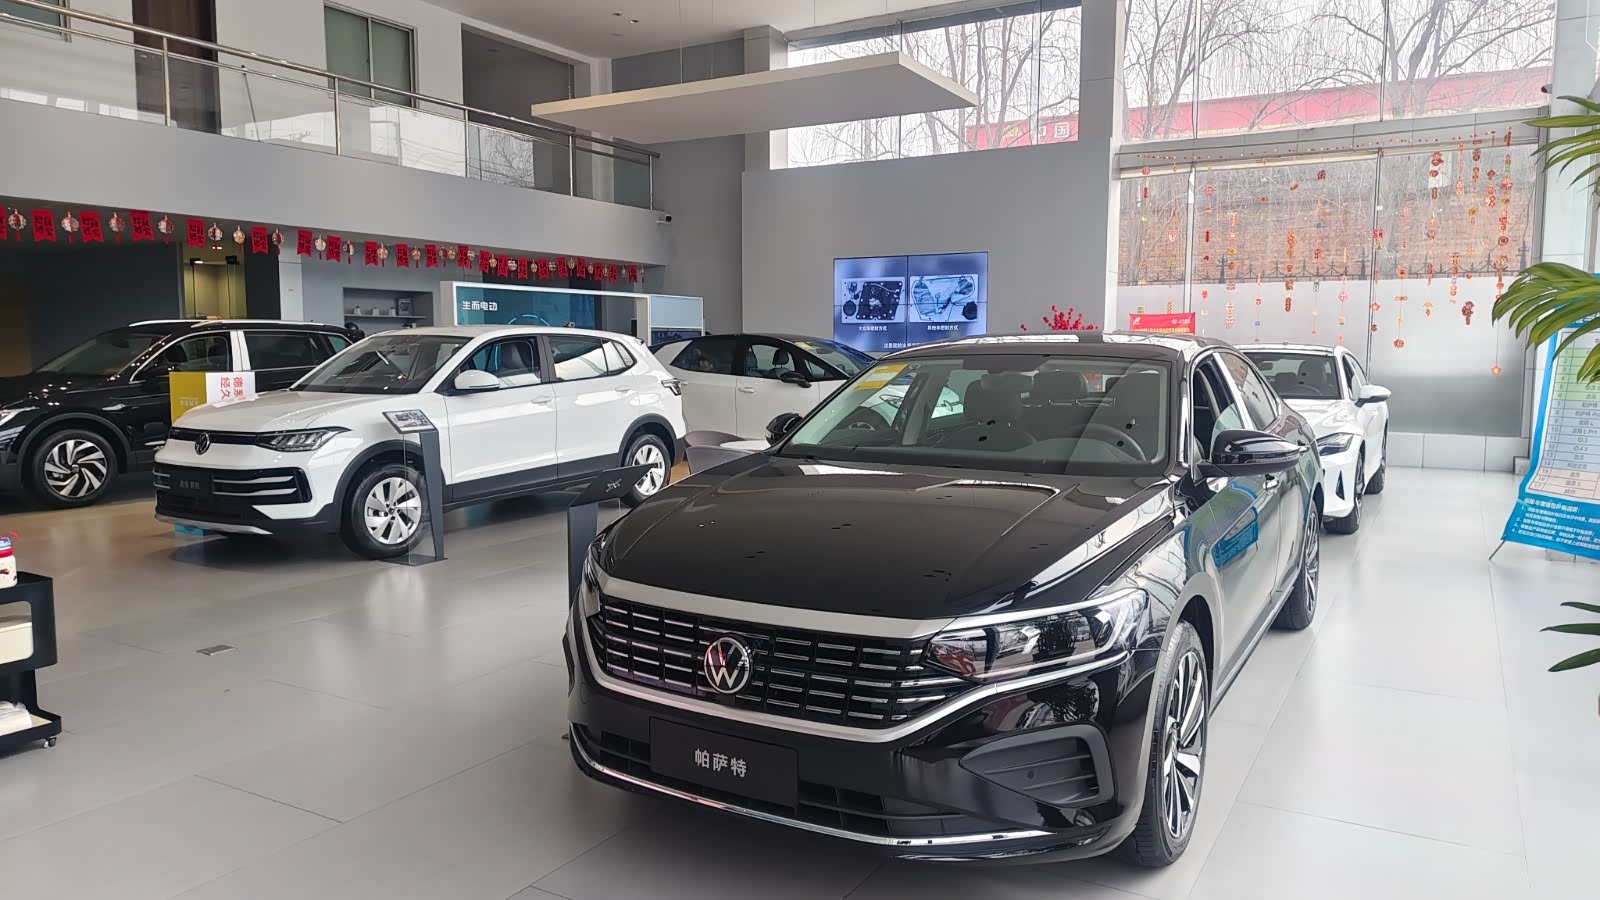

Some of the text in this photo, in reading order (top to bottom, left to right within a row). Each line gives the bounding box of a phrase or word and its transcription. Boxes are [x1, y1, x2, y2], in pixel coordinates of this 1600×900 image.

[462, 300, 498, 311] 生而电动
[694, 748, 747, 778] 帕萨特
